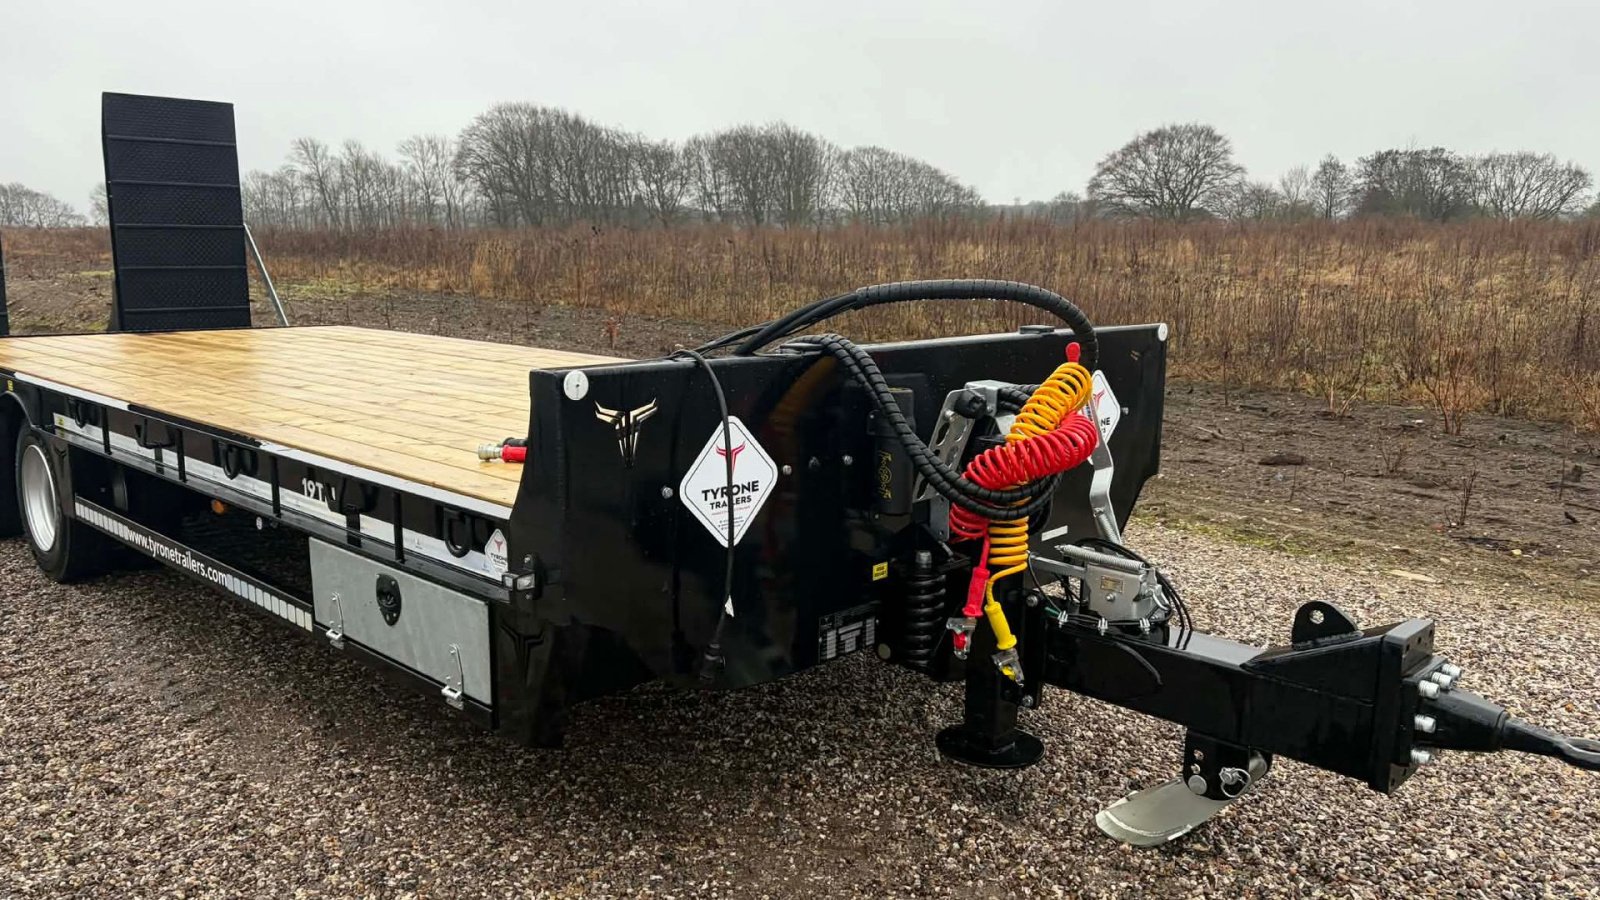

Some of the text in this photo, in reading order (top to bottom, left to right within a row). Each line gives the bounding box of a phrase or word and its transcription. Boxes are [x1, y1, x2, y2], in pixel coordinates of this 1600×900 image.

[701, 480, 759, 501] TYRONE
[709, 495, 752, 510] TRAERS
[127, 529, 228, 586] www.tyronetrailers.com
